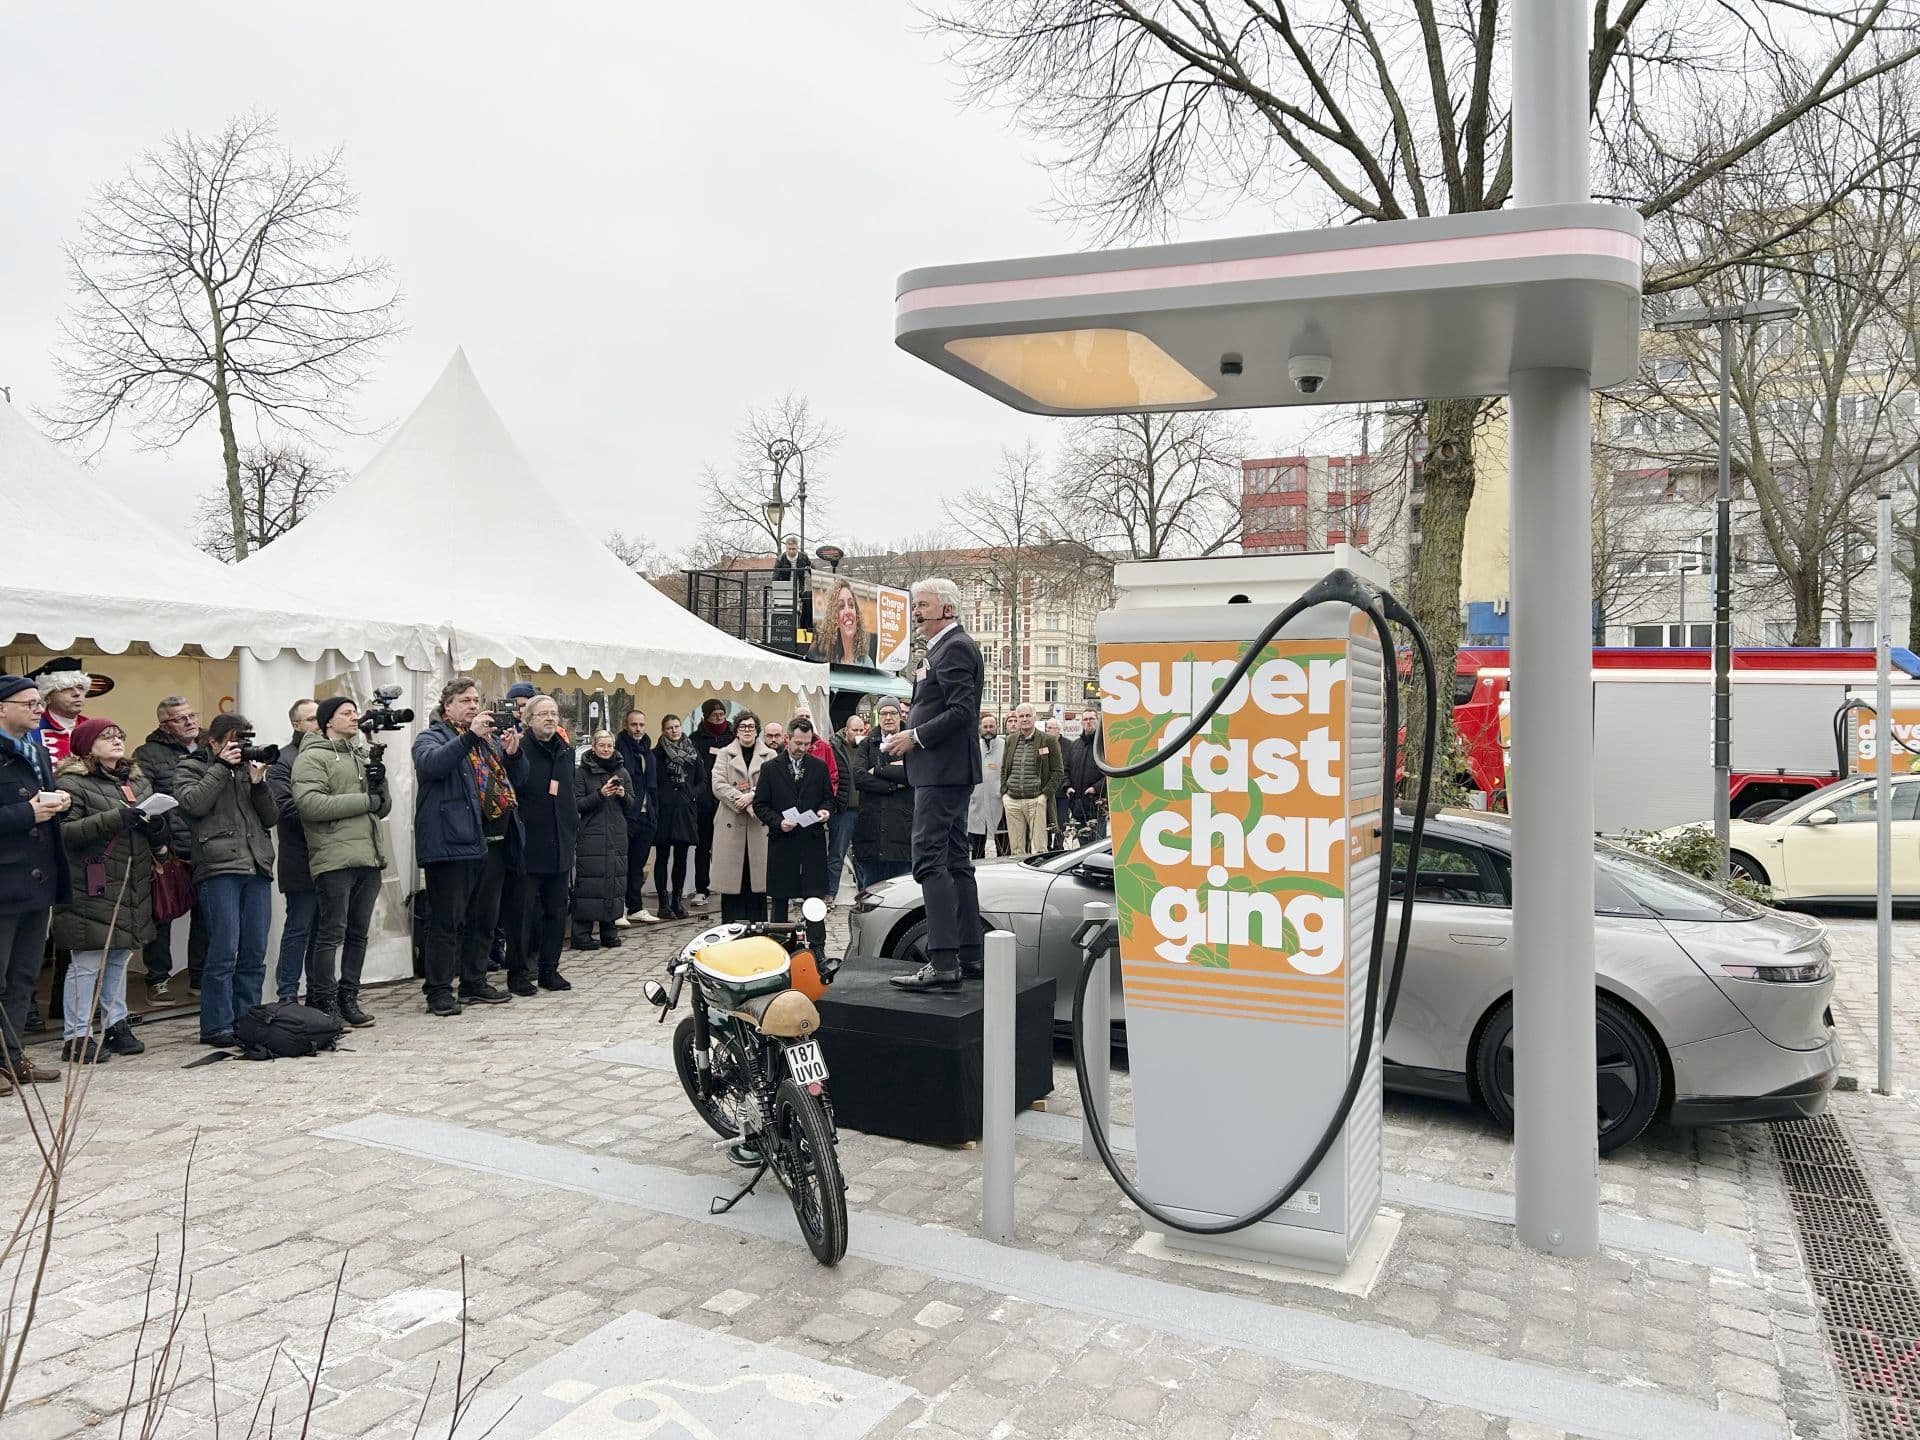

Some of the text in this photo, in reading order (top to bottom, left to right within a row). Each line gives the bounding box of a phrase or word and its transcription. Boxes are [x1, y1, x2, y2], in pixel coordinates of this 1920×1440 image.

[881, 596, 905, 611] Charge
[881, 607, 896, 620] with
[1099, 658, 1346, 734] super
[1859, 718, 1920, 740] dive
[1158, 716, 1341, 796] fast
[1140, 793, 1345, 873] char
[1151, 865, 1344, 975] ging
[790, 1043, 814, 1065] 187
[795, 1062, 823, 1082] UVO
